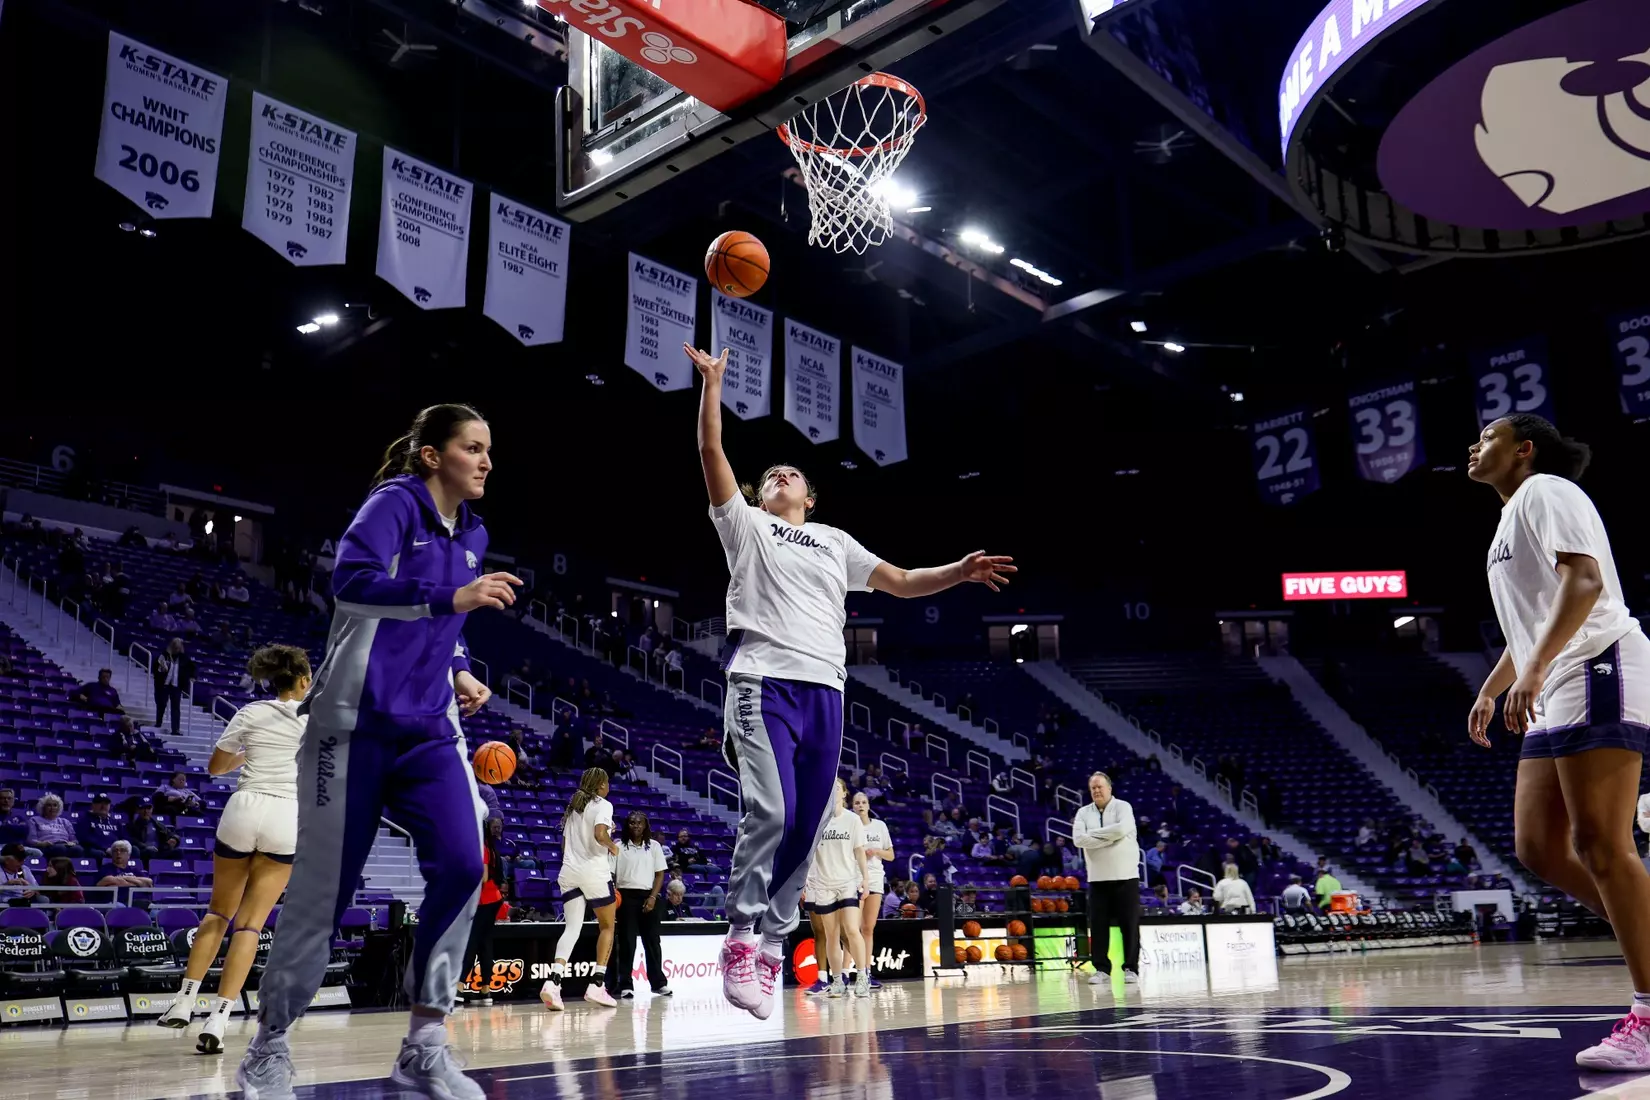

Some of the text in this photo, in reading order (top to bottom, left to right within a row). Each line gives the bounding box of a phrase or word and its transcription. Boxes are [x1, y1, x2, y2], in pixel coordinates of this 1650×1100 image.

[548, 0, 645, 38] Sta
[1319, 14, 1342, 72] A
[119, 44, 217, 96] K-STATE
[125, 62, 208, 101] WOMEN'S BASKETBALL
[143, 96, 189, 124] WNIT
[111, 101, 216, 154] CHAMPIONS
[262, 104, 348, 149] K-STATE
[268, 120, 340, 154] WOMEN'S BASKETBALL
[119, 144, 200, 193] 2006
[259, 147, 346, 188] CHAMPIONSHIPS
[269, 141, 337, 173] CONFERENCE
[267, 168, 335, 201] 1976 1982
[391, 157, 465, 199] K-STATE
[266, 182, 334, 214] 1977 1983
[399, 192, 457, 222] CONFERENCE
[266, 195, 333, 227] 1978 1984
[391, 198, 465, 235] CHAMPIONSHIPS
[497, 202, 563, 240] K-STATE
[265, 208, 332, 240] 1979 1987
[397, 219, 421, 235] 2004
[396, 230, 420, 247] 2008
[520, 242, 538, 254] NCAA
[499, 241, 558, 273] ELITE EIGHT
[503, 260, 524, 275] 1982
[635, 261, 692, 294] K-STATE
[633, 294, 694, 326] SWEET SIXTEEN
[640, 313, 659, 327] 1983
[717, 296, 768, 326] K-STATE
[640, 324, 659, 338] 1984
[729, 326, 756, 346] NCAA
[1619, 315, 1650, 332] BOO
[640, 336, 659, 349] 2002
[790, 326, 836, 354] K-STATE
[640, 346, 659, 360] 2025
[745, 354, 762, 366] 1997
[800, 355, 825, 373] NCAA
[1490, 350, 1525, 367] PARR
[1617, 336, 1650, 386] 3
[745, 365, 762, 377] 2002
[857, 354, 898, 379] K-STATE
[745, 375, 762, 388] 2003
[745, 385, 762, 398] 2004
[867, 382, 889, 398] NCAA
[1479, 363, 1547, 420] 33
[1355, 400, 1415, 454] 33
[51, 444, 75, 473] 6
[1255, 427, 1312, 480] 22
[552, 553, 569, 576] 8
[1285, 575, 1403, 595] FIVE GUYS
[924, 605, 941, 625] 9
[1123, 600, 1150, 621] 10
[316, 735, 338, 808] Wildcats
[0, 932, 42, 946] Capitol
[124, 931, 166, 944] Capitol
[126, 941, 168, 953] Federal
[1154, 928, 1198, 943] Ascension
[0, 943, 43, 956] Federal
[876, 947, 910, 972] Hut
[1154, 947, 1202, 962] Via Christi
[531, 963, 573, 979] SINE
[574, 961, 597, 977] 197
[663, 959, 725, 979] SMOOTH
